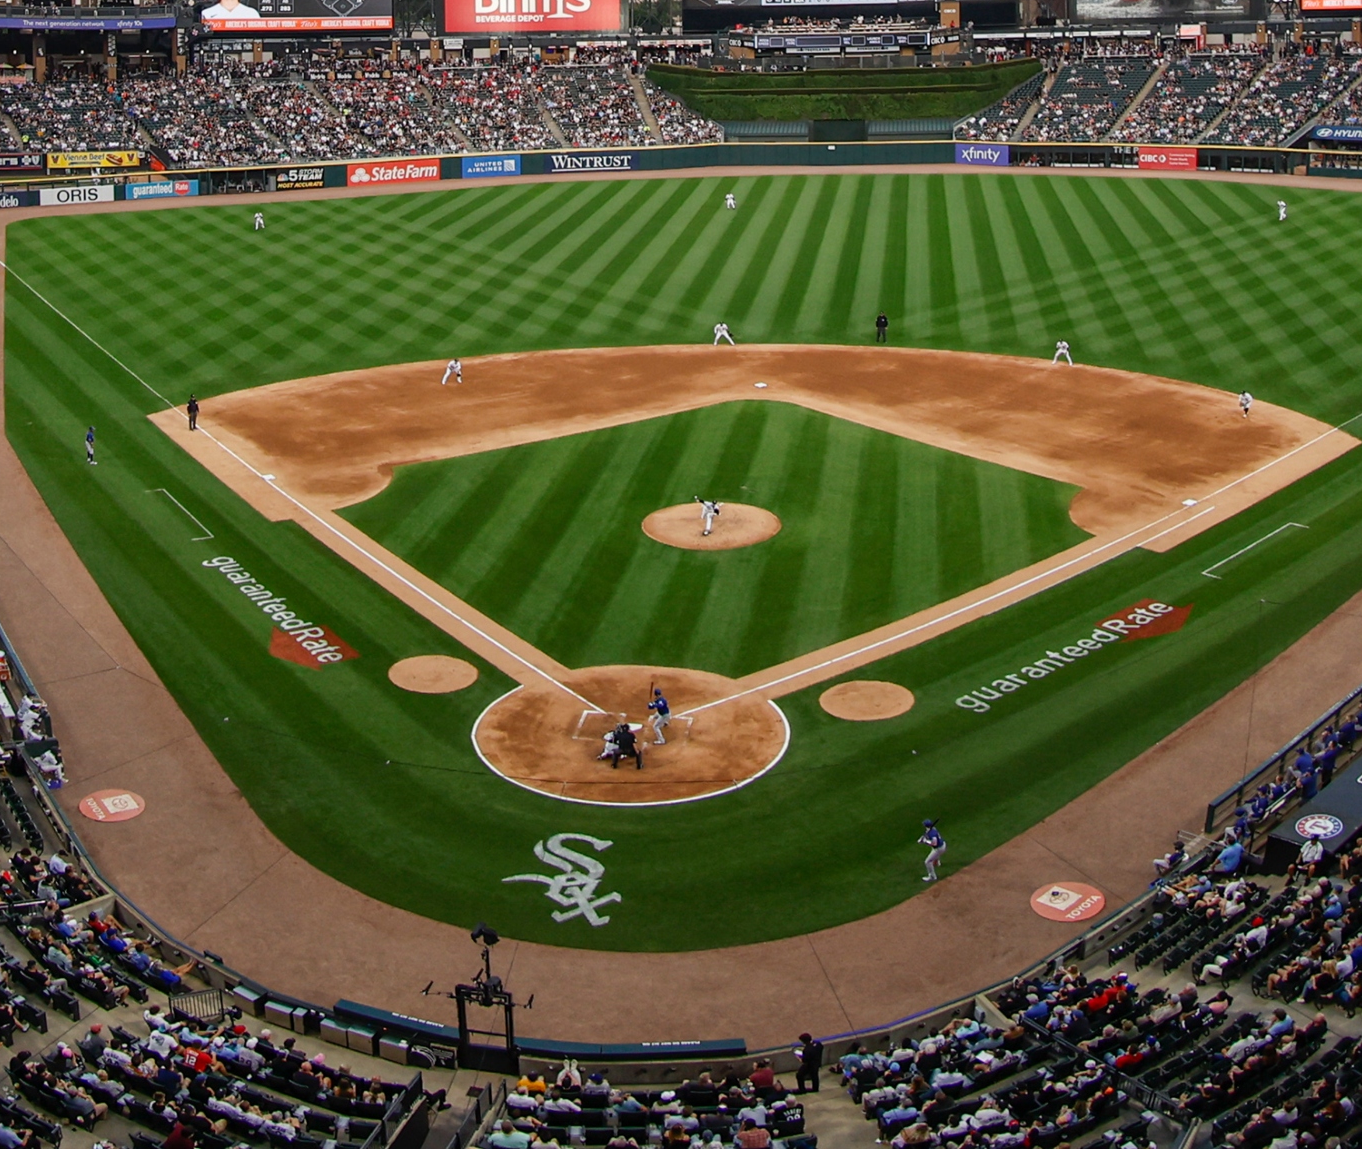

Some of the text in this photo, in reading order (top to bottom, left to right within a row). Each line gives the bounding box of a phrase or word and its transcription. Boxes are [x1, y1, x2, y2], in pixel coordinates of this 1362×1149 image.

[46, 20, 79, 29] generation
[80, 20, 105, 28] network
[475, 14, 544, 23] BEVERAGE DEPOT
[961, 146, 1001, 163] xfinity
[1113, 146, 1132, 154] THE
[63, 153, 105, 162] Vienna Beef
[551, 154, 632, 169] WINTRUST
[1139, 154, 1158, 162] CIBC
[288, 169, 298, 181] 5
[298, 173, 323, 181] TEAM
[133, 181, 173, 198] guaranteed
[293, 180, 324, 188] ACCURATE
[57, 188, 99, 203] ORIS
[201, 555, 344, 663] guaranteed Rate
[954, 601, 1175, 713] guaranteed Rate
[85, 797, 106, 821] TOYOTA
[1064, 895, 1102, 920] TOYOTA
